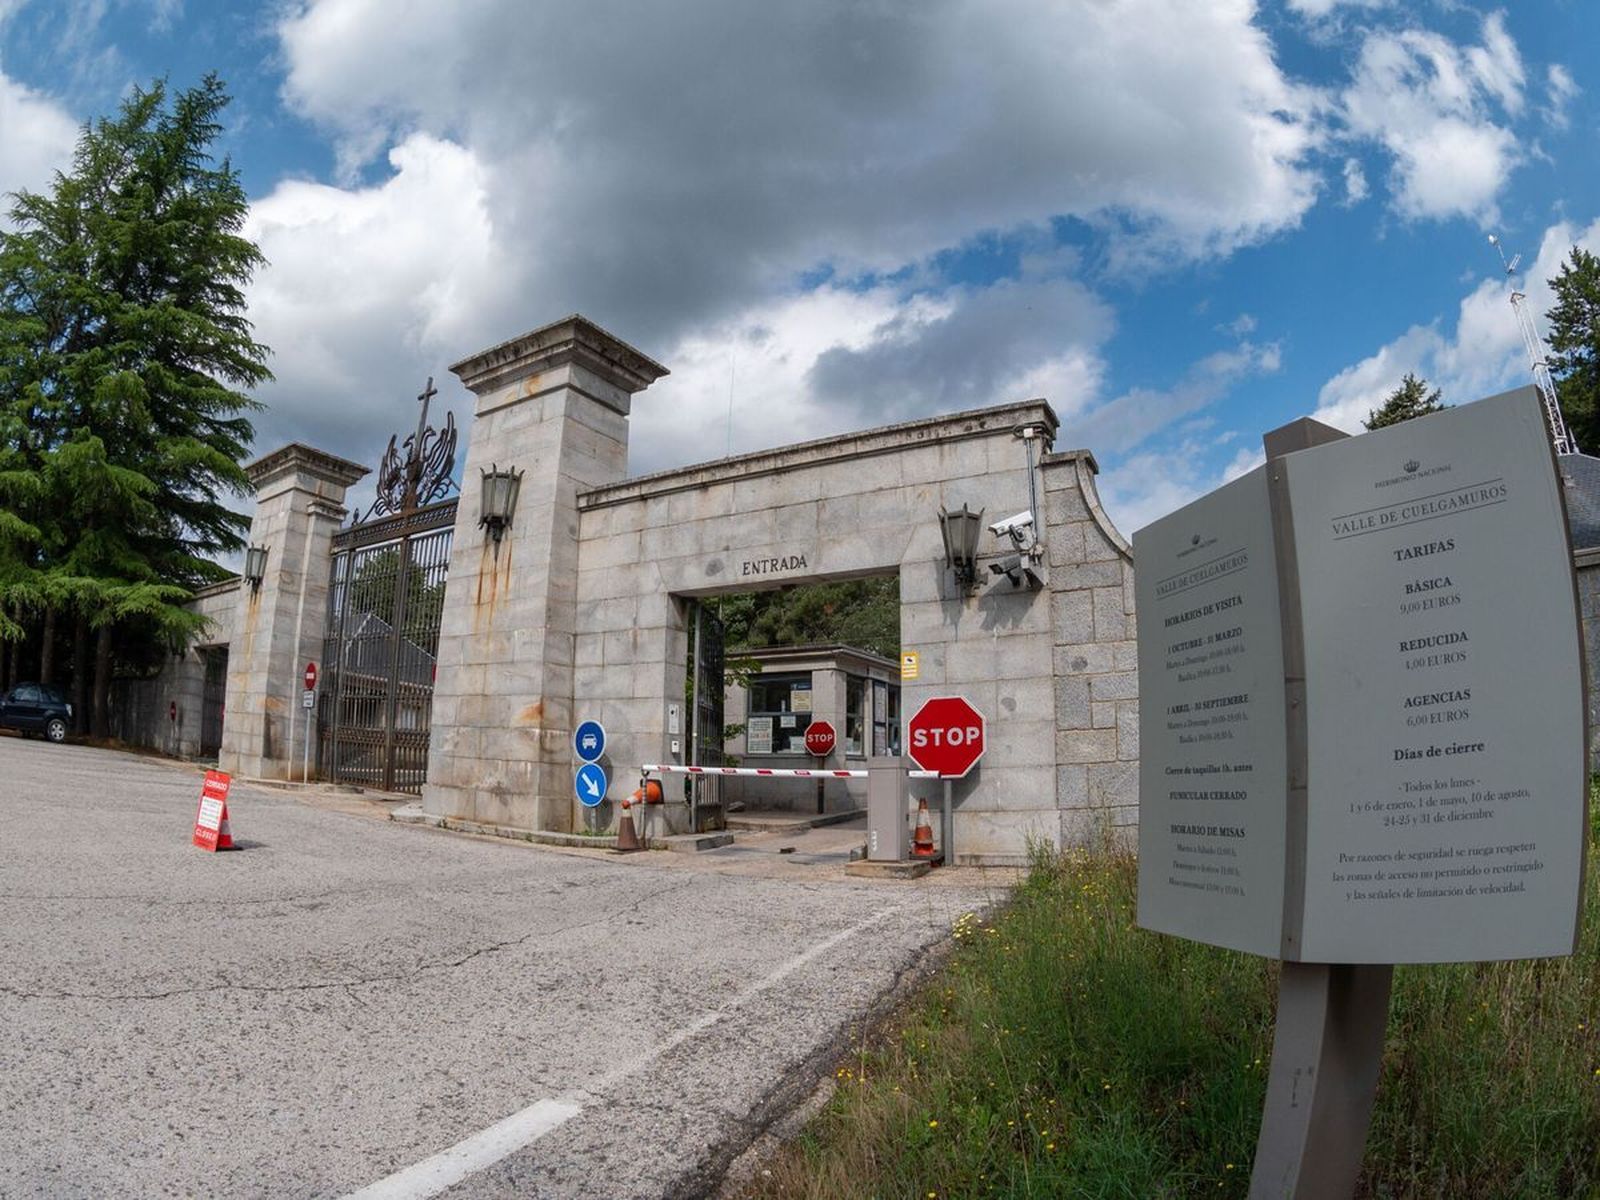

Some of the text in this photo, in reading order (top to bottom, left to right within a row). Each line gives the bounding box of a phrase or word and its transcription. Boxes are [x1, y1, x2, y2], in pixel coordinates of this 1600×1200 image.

[1332, 484, 1507, 534] VALLE DE CUELGAMUROS
[1393, 538, 1455, 561] TARIFAS
[742, 554, 808, 576] ENTRADA
[1405, 576, 1452, 594] BÁSICA
[1164, 595, 1243, 627] HORARIOS DE VISITA
[1400, 594, 1461, 615] 9,00 EUROS
[1172, 638, 1203, 653] OCTUBRE
[1215, 627, 1242, 642] MARZO
[1400, 631, 1469, 651] REDUCIDA
[1427, 651, 1467, 667] EUROS
[1171, 704, 1190, 714] ABRIL
[1203, 693, 1249, 710] SEPTIEMBRE
[1403, 688, 1471, 709] AGENCIAS
[1407, 709, 1469, 727] 6,00 EUROS
[807, 734, 833, 743] STOP
[913, 726, 980, 747] STOP
[1394, 742, 1485, 761] Días de cierre
[1404, 779, 1431, 792] Todos
[1434, 779, 1448, 789] los
[1450, 778, 1475, 789] lunes
[1170, 791, 1247, 800] FUNICULAR CERRADO
[1364, 801, 1371, 811] 6
[1373, 800, 1385, 811] de
[1426, 797, 1438, 807] de
[1440, 796, 1468, 807] mayo,
[1471, 791, 1482, 803] 10
[1484, 791, 1496, 801] de
[1422, 813, 1431, 824] 31
[1434, 811, 1446, 823] de
[1447, 808, 1495, 822] diciembre
[1171, 824, 1245, 838] HORARIO DE MISAS
[1339, 843, 1536, 864] Por razones de seguridad se ruega respeten
[1332, 872, 1346, 882] las
[1347, 873, 1371, 881] zonas
[1374, 870, 1387, 881] de
[1388, 872, 1418, 880] acceso
[1420, 870, 1433, 878] no
[1435, 865, 1481, 880] permitido
[1492, 859, 1544, 875] restringido
[1353, 889, 1366, 899] las
[1367, 888, 1402, 899] señales
[1403, 888, 1416, 898] de
[1417, 886, 1463, 898] limitación
[1465, 885, 1477, 895] de
